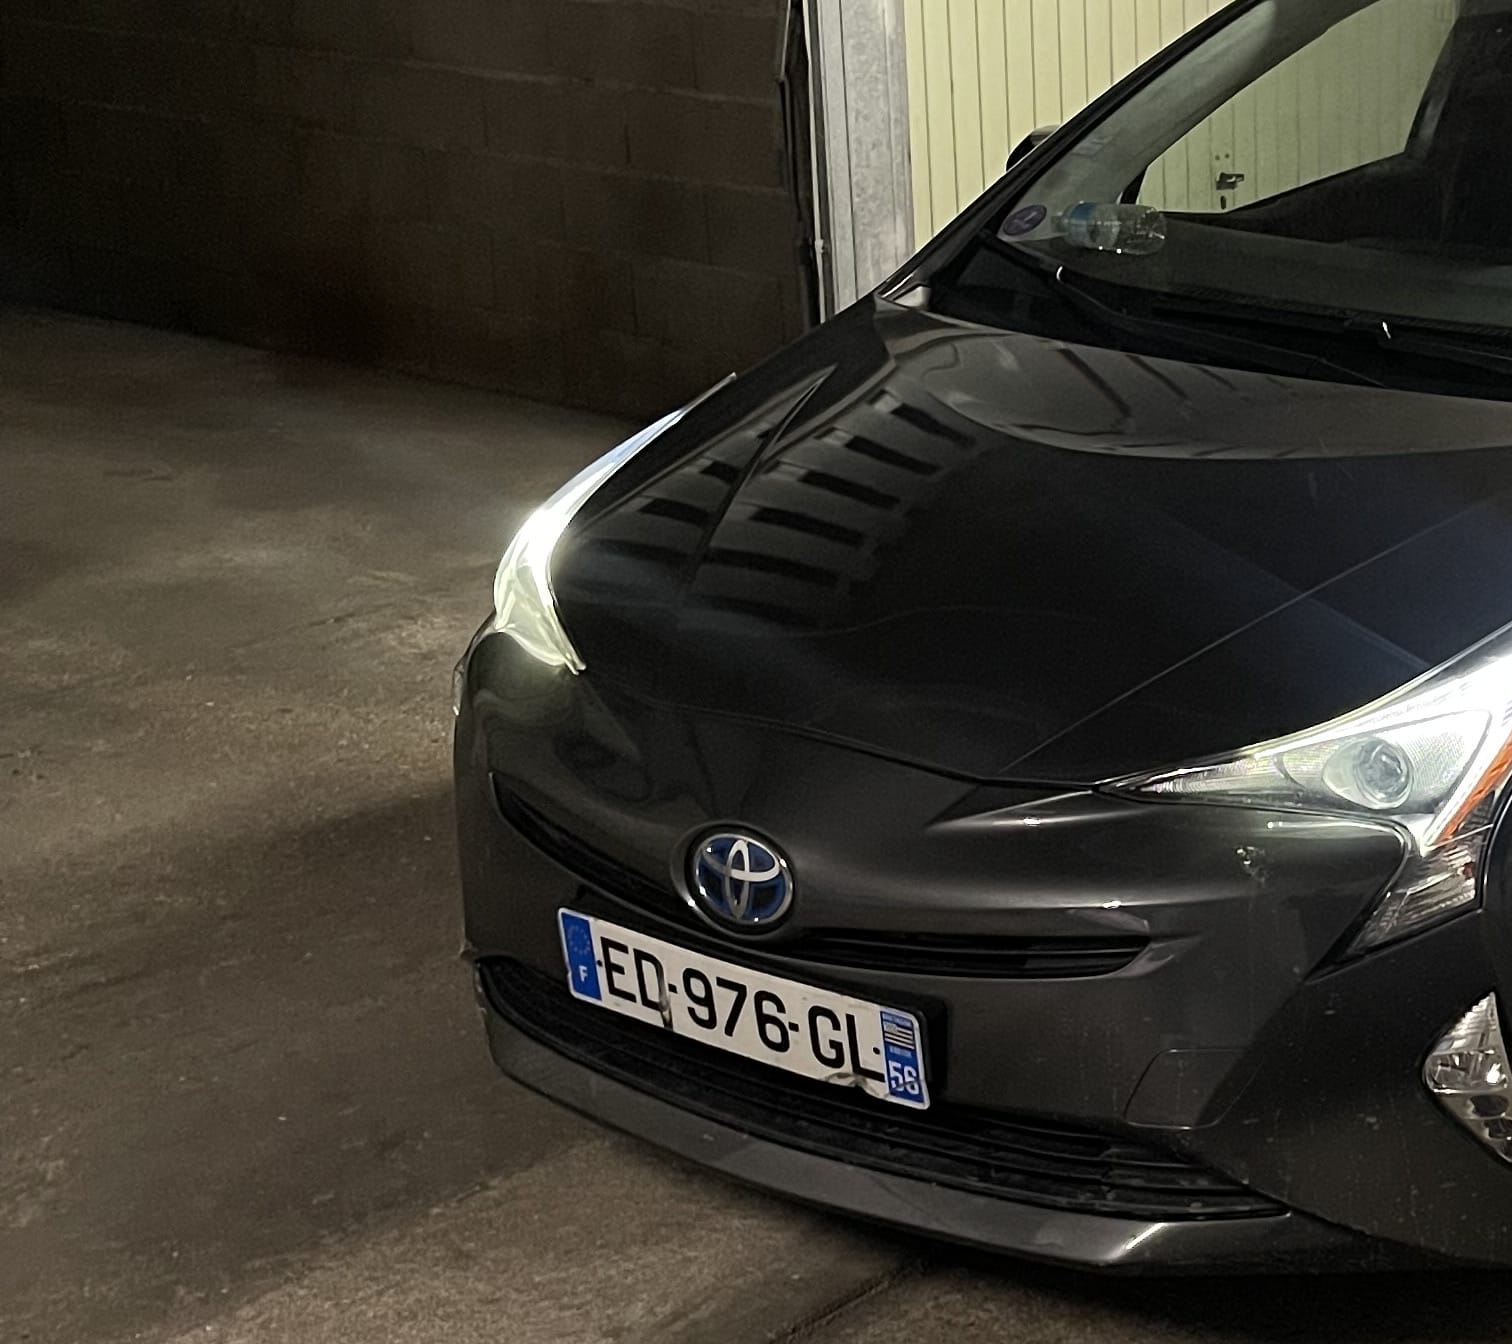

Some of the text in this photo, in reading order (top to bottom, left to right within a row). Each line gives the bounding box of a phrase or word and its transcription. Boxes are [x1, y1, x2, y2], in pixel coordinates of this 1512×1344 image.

[578, 965, 589, 983] F
[600, 936, 885, 1083] ED-976-GL
[888, 1059, 920, 1095] 56
